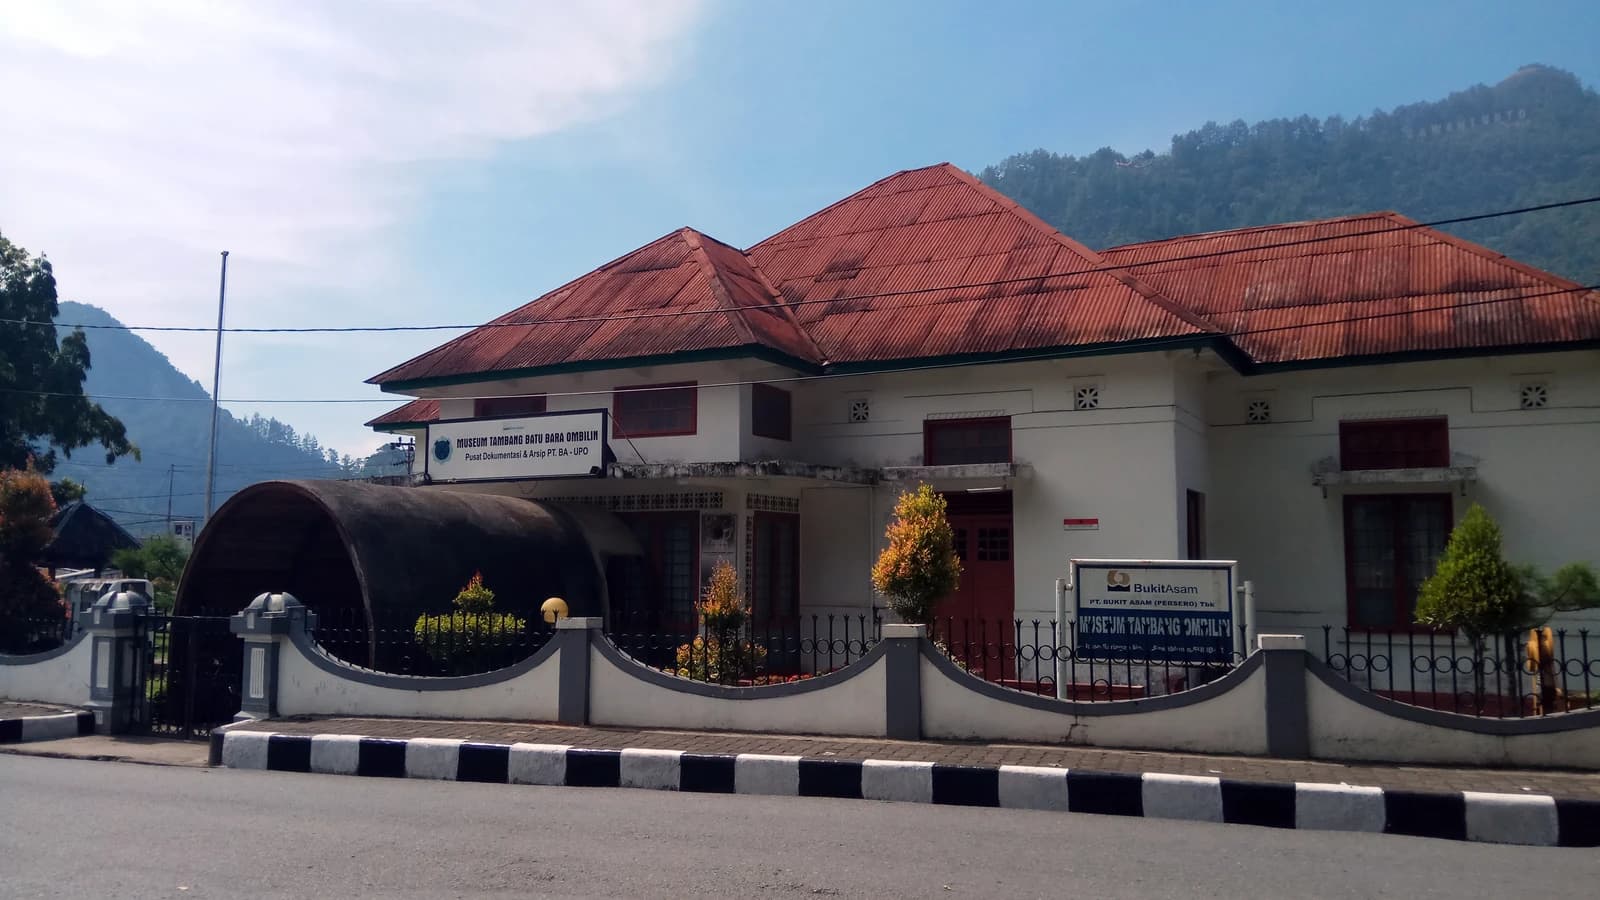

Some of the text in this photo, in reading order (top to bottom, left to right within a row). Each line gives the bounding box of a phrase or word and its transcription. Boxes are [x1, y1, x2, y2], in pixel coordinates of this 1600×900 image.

[457, 430, 598, 448] MUSEUM TAMBANG BATU BARA OMBILIN
[465, 453, 482, 461] Pusat
[483, 450, 521, 460] Dokumentasi
[529, 449, 546, 459] Arsip
[547, 448, 557, 457] PT.
[558, 448, 568, 456] BA
[574, 447, 588, 455] UPO
[1134, 583, 1198, 594] BukitAsam
[1154, 600, 1198, 608] (PERSERO)
